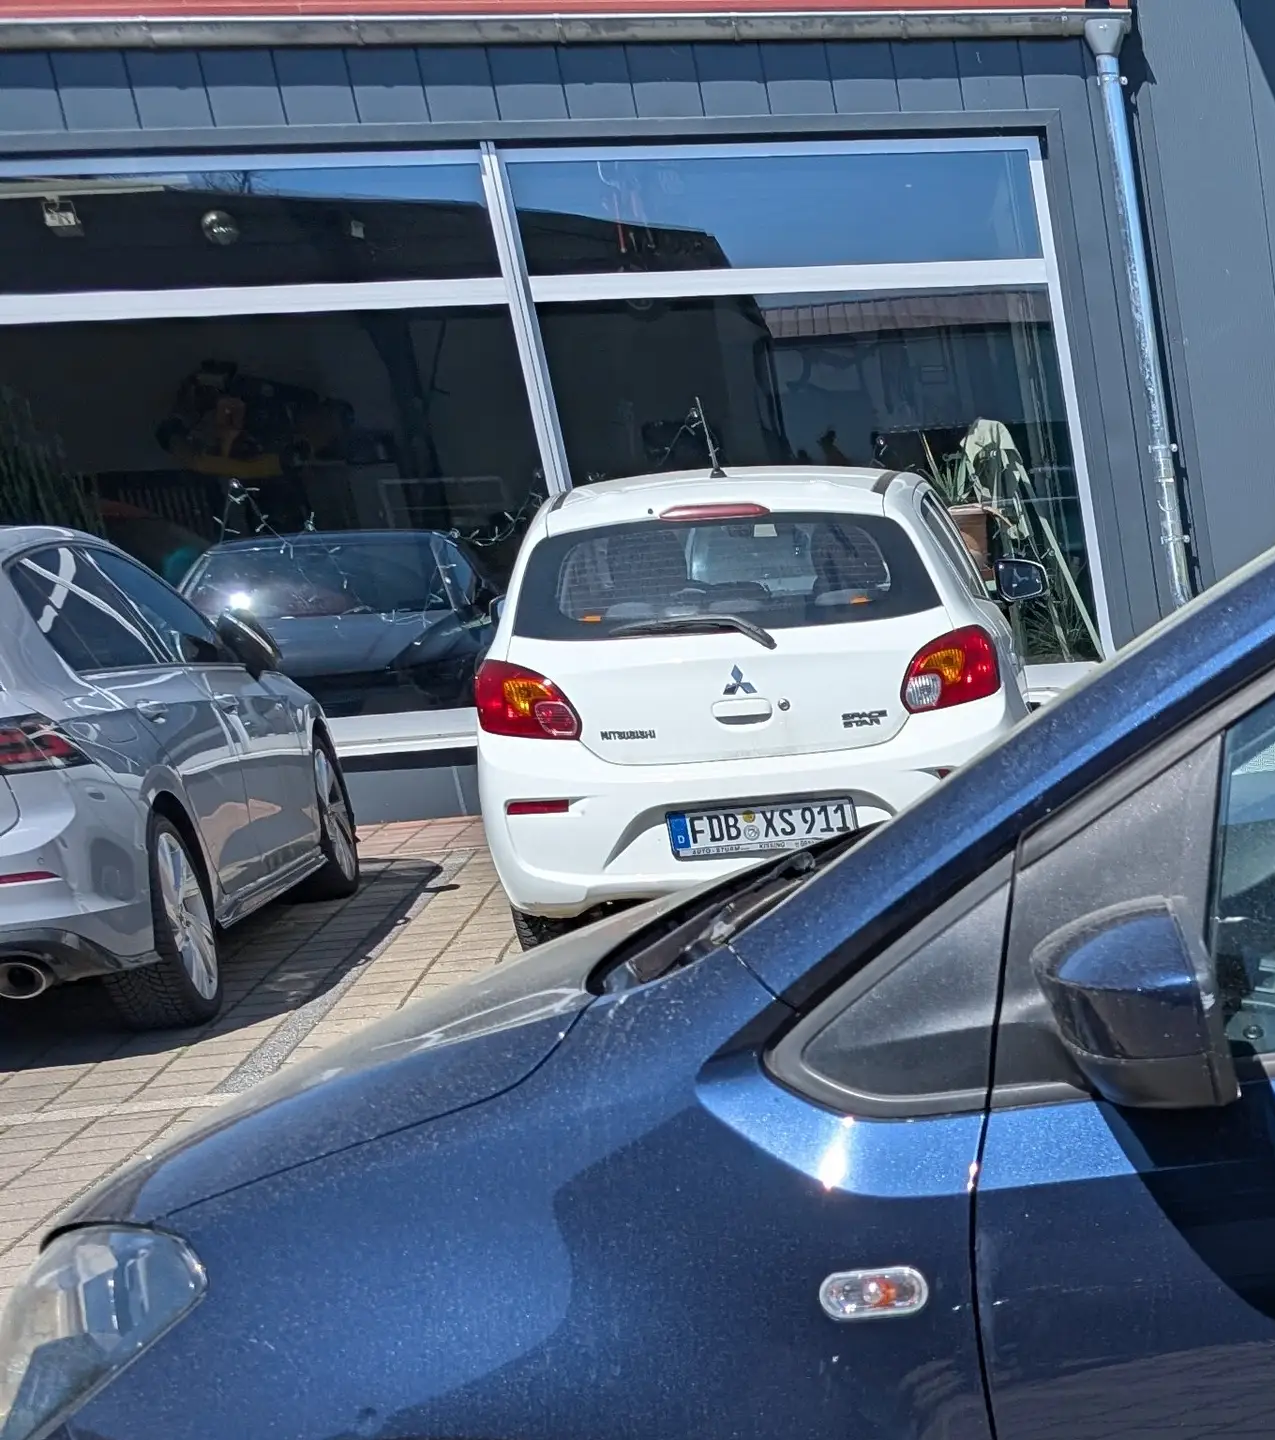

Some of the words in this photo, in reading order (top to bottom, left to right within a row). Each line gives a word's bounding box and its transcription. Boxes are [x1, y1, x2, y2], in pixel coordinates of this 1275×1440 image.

[689, 813, 742, 844] FDB
[760, 810, 796, 838] XS
[801, 804, 851, 834] 911
